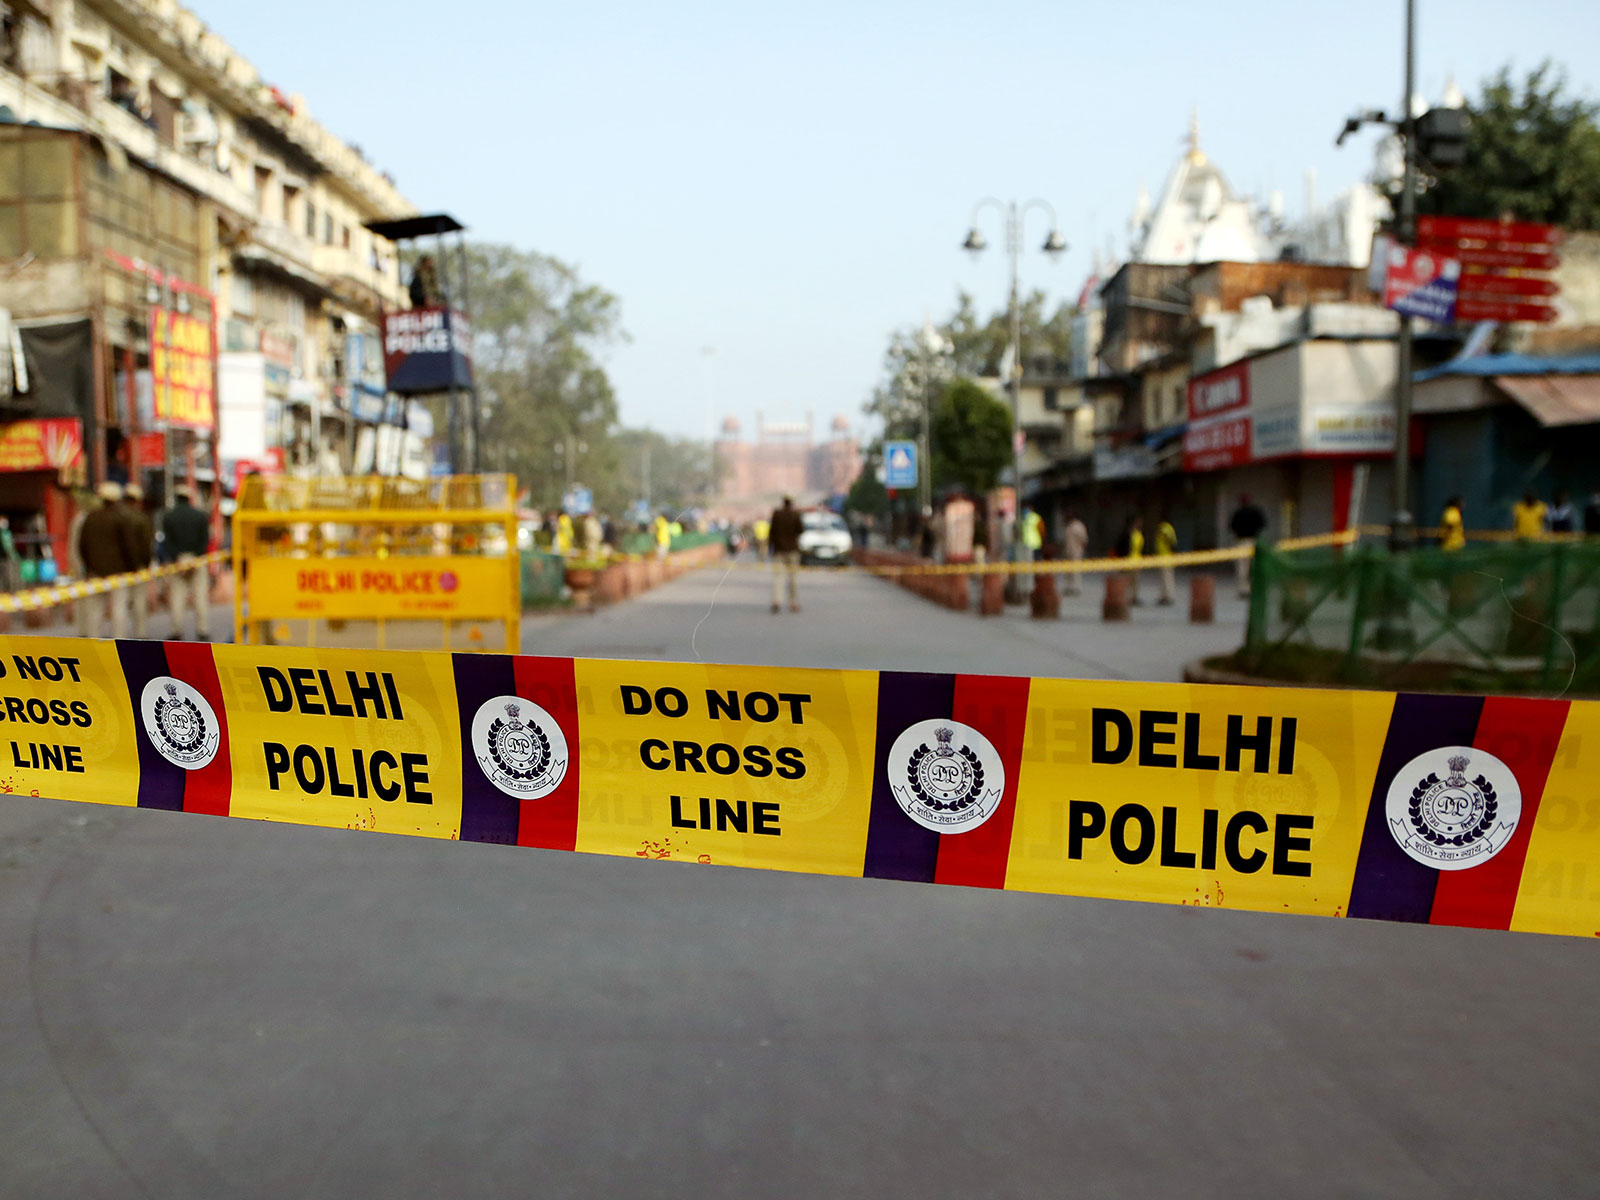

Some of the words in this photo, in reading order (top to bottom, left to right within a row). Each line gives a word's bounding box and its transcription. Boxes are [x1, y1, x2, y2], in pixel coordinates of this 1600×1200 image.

[11, 655, 82, 683] NOT
[0, 696, 93, 728] ROSS
[256, 666, 404, 721] DELHI
[619, 685, 689, 718] DO
[705, 689, 812, 725] NOT
[9, 741, 86, 774] LINE
[639, 739, 807, 780] CROSS
[1091, 707, 1299, 775] DELHI
[263, 744, 433, 805] POLICE
[670, 796, 783, 836] LINE
[1068, 800, 1315, 878] POLICE
